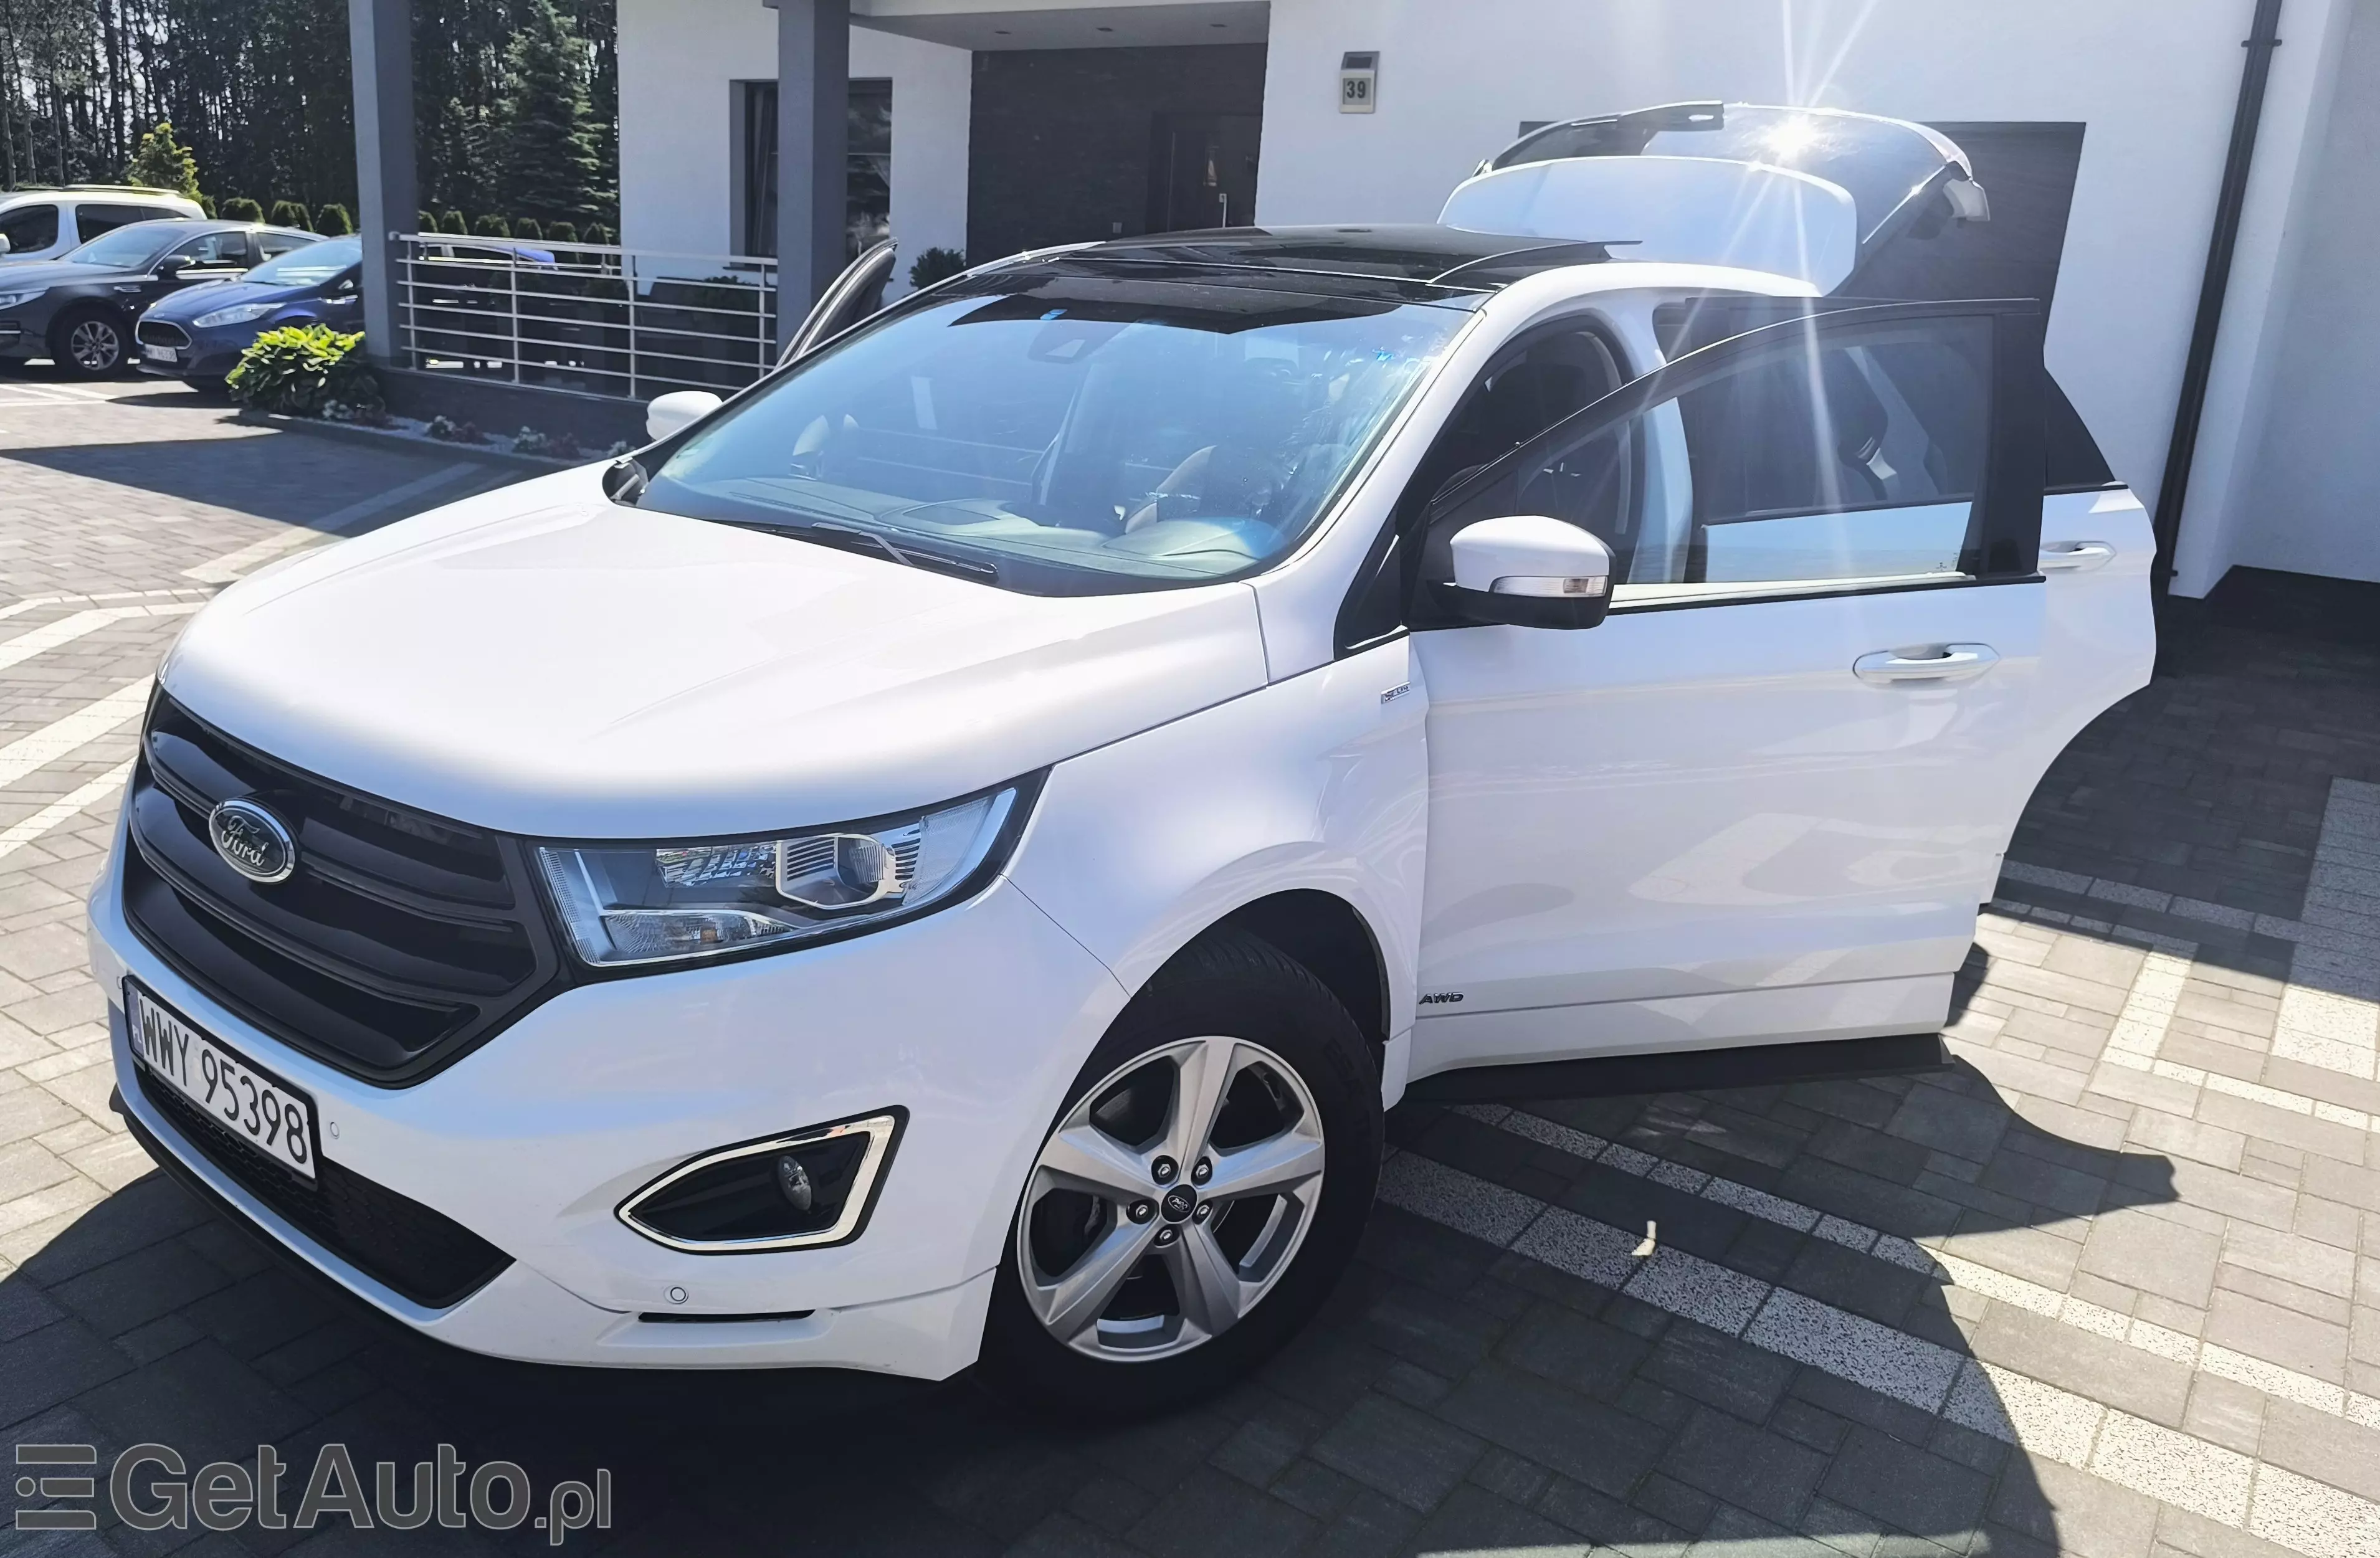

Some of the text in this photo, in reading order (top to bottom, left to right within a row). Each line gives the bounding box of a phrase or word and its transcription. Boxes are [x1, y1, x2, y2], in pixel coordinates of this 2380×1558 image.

[1346, 80, 1366, 98] 39
[221, 815, 269, 866] Ford
[1419, 992, 1464, 1005] AWD
[132, 1024, 142, 1043] PL
[140, 999, 307, 1164] WWY 95398
